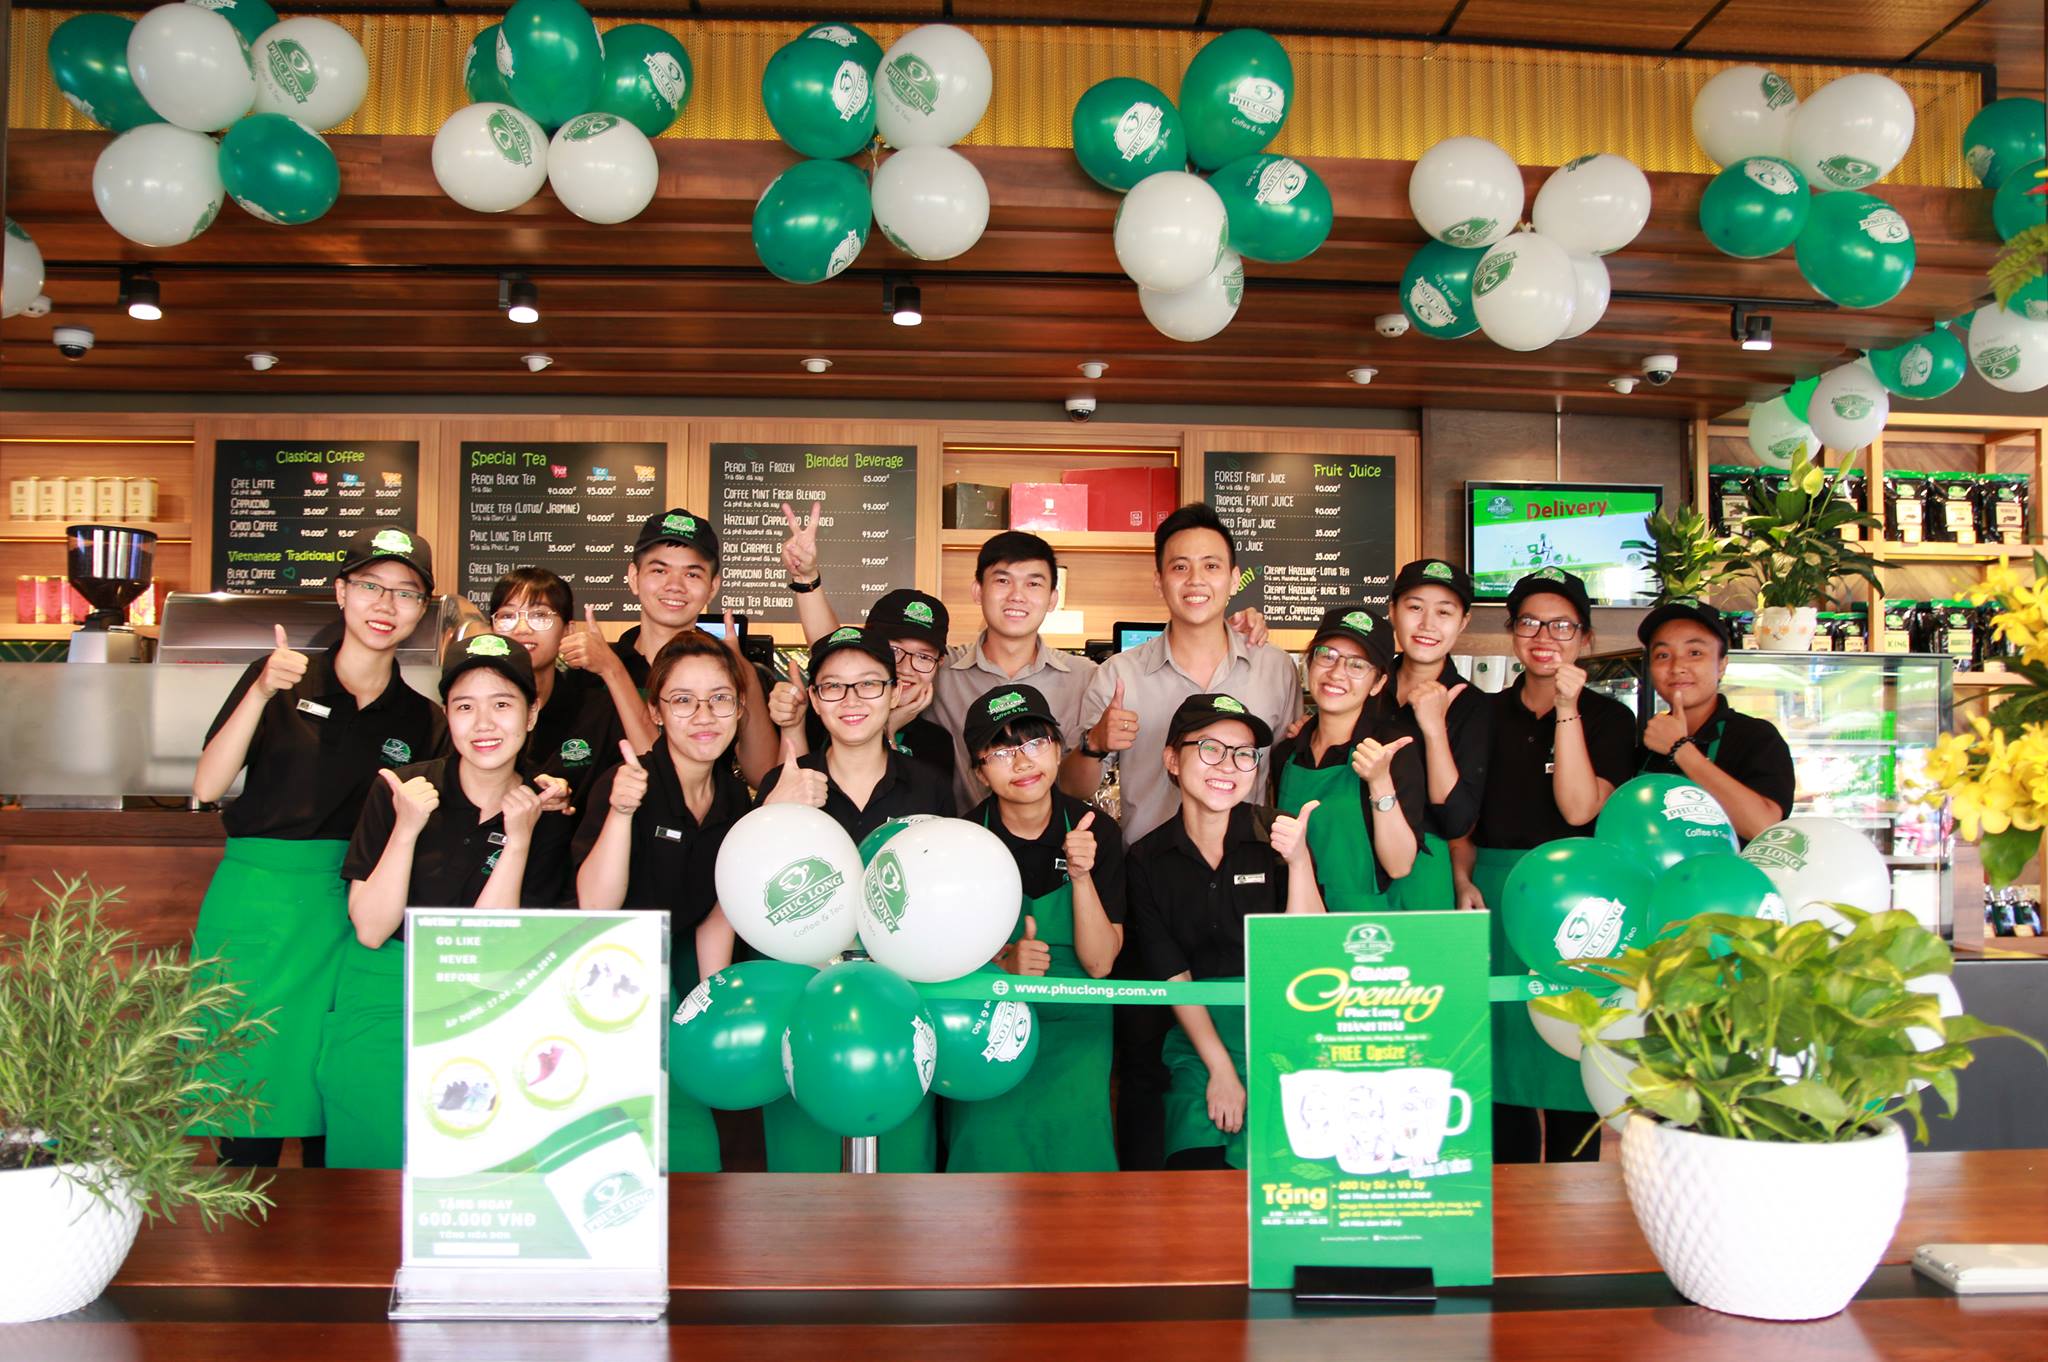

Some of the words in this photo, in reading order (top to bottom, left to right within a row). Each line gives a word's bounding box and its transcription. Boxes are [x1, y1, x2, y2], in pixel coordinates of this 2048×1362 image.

[284, 70, 306, 103] LONG
[886, 64, 909, 90] PHUC
[905, 86, 933, 116] LONG
[1231, 95, 1261, 113] PHUC
[1125, 134, 1146, 161] PHUC
[1143, 110, 1163, 136] LONG
[276, 450, 322, 464] Classical
[327, 450, 365, 463] Coffee
[472, 451, 516, 468] Special
[522, 452, 547, 466] Tea
[805, 453, 849, 469] Blended
[855, 453, 904, 468] Beverage
[724, 461, 746, 472] PEACH
[751, 462, 764, 472] TEA
[769, 461, 795, 472] FROZEN
[1313, 463, 1343, 478] Fruit
[1349, 464, 1381, 479] Juice
[252, 478, 275, 489] LATTE
[471, 473, 494, 485] PEACH
[497, 473, 519, 485] BLACK
[522, 473, 536, 485] TEA
[1215, 471, 1243, 482] FOREST
[1246, 472, 1265, 482] FRUIT
[1268, 472, 1286, 483] JUICE
[724, 488, 749, 499] COFFEE
[752, 489, 770, 500] MINT
[773, 488, 793, 500] FRESH
[796, 489, 826, 501] BLENDED
[1215, 494, 1243, 506] TROPICAL
[1246, 495, 1269, 507] FRUIT
[1271, 495, 1294, 507] JUICE
[498, 503, 512, 513] TEA
[1526, 499, 1609, 520] Delivery
[724, 514, 759, 525] HAZELNUT
[1237, 517, 1256, 528] FRUIT
[1258, 518, 1276, 529] JUICE
[512, 531, 526, 542] TEA
[528, 531, 553, 542] LATTE
[741, 542, 773, 554] CARAMEL
[1245, 540, 1264, 552] JUICE
[227, 551, 282, 562] Vietnamese
[286, 550, 335, 562] Traditional
[469, 562, 493, 574] GREEN
[495, 562, 509, 574] TEA
[764, 568, 787, 579] BLAST
[1264, 566, 1287, 575] CREAMY
[1339, 567, 1350, 576] TEA
[1264, 585, 1287, 594] CREAMY
[1339, 586, 1350, 595] TEA
[721, 595, 745, 607] GREEN
[747, 596, 760, 607] TEA
[763, 596, 793, 608] BLENDED
[1264, 605, 1286, 614] CREAMY
[1668, 805, 1701, 819] PHUC
[1685, 828, 1712, 838] Coffee
[1765, 847, 1801, 871] LONG
[771, 895, 808, 924] PHUC
[807, 875, 844, 901] LONG
[875, 890, 897, 931] LONG
[1598, 906, 1622, 940] LONG
[435, 936, 453, 946] GO
[456, 936, 482, 946] LIKE
[439, 954, 478, 965] NEVER
[435, 972, 481, 983] BEFORE
[1014, 983, 1167, 998] www.phuclong.com.vn
[1286, 967, 1445, 1022] Opening
[1331, 1045, 1362, 1061] FREE
[1367, 1045, 1406, 1061] Upsize
[1262, 1183, 1328, 1210] Tặng
[418, 1212, 493, 1227] 600.000
